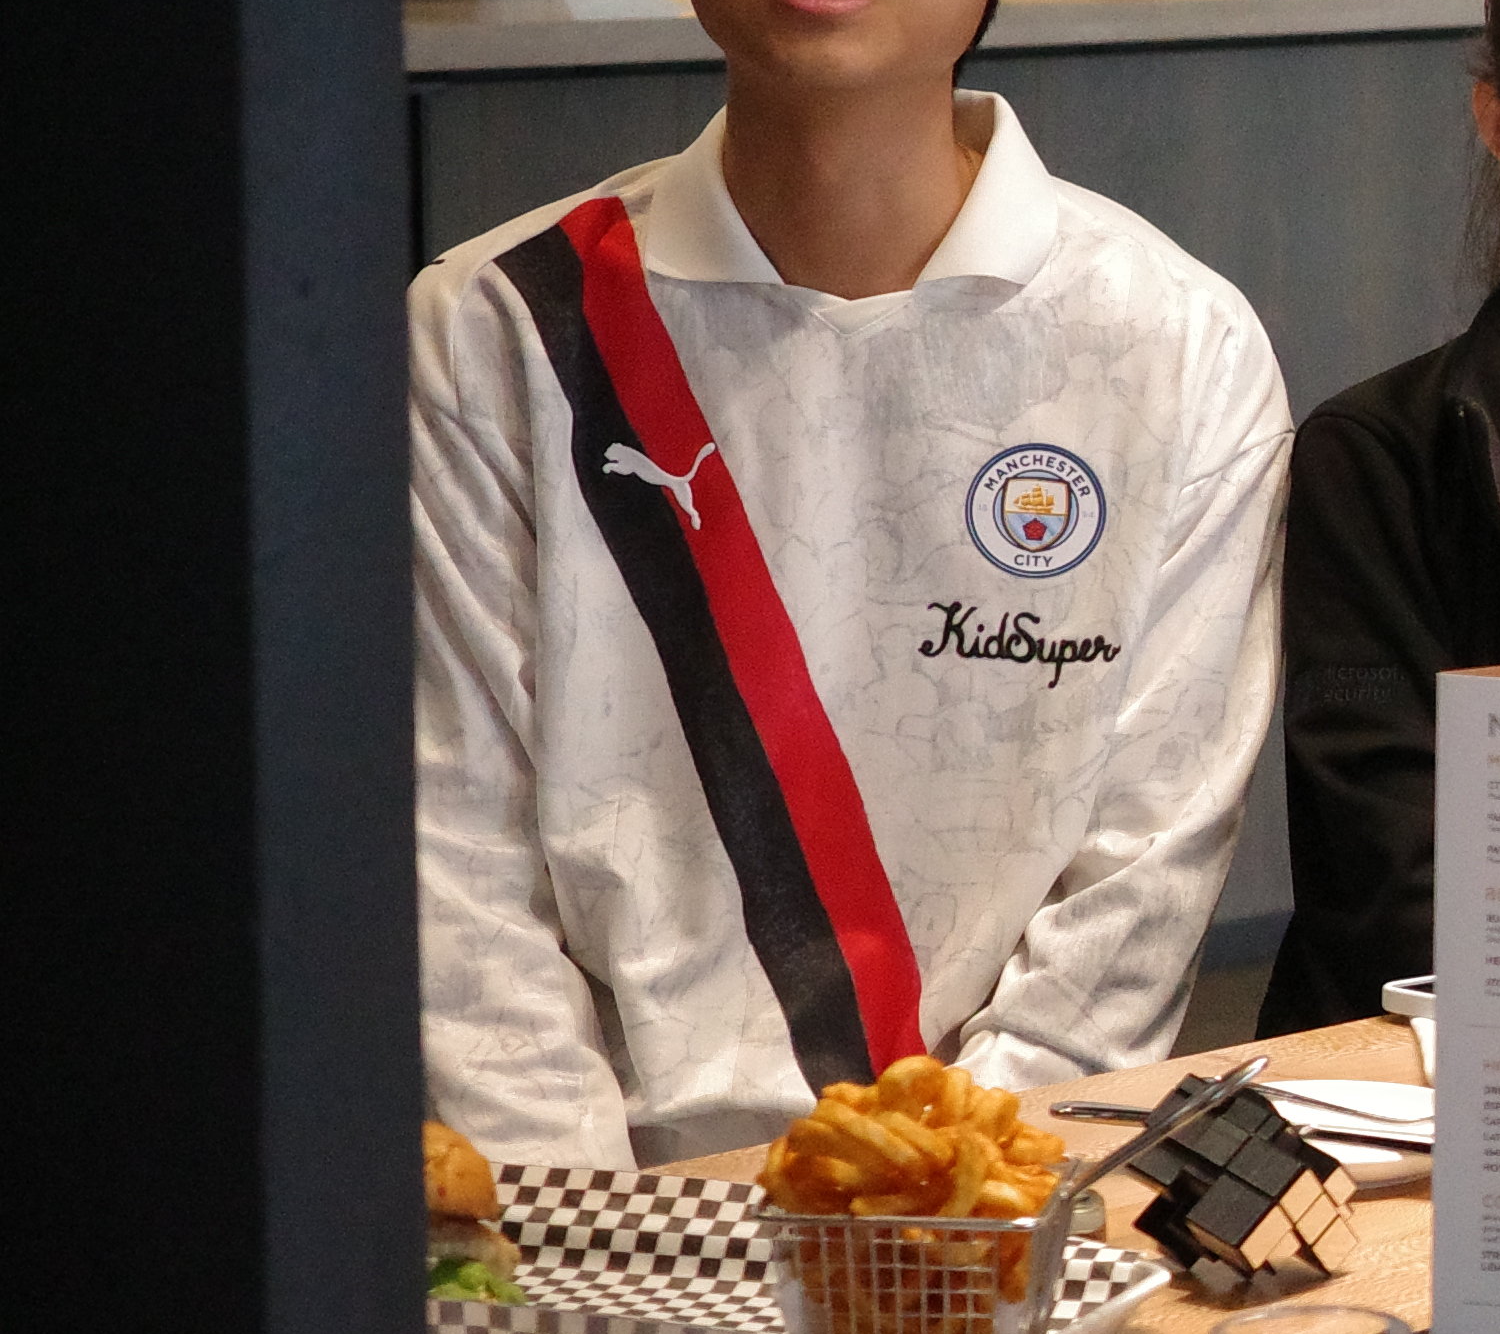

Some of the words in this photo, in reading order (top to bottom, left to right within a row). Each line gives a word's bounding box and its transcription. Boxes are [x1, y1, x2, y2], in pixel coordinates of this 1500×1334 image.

[983, 454, 1091, 498] MANCHESTER
[1013, 554, 1054, 567] CITY
[918, 601, 1121, 688] KidSuper
